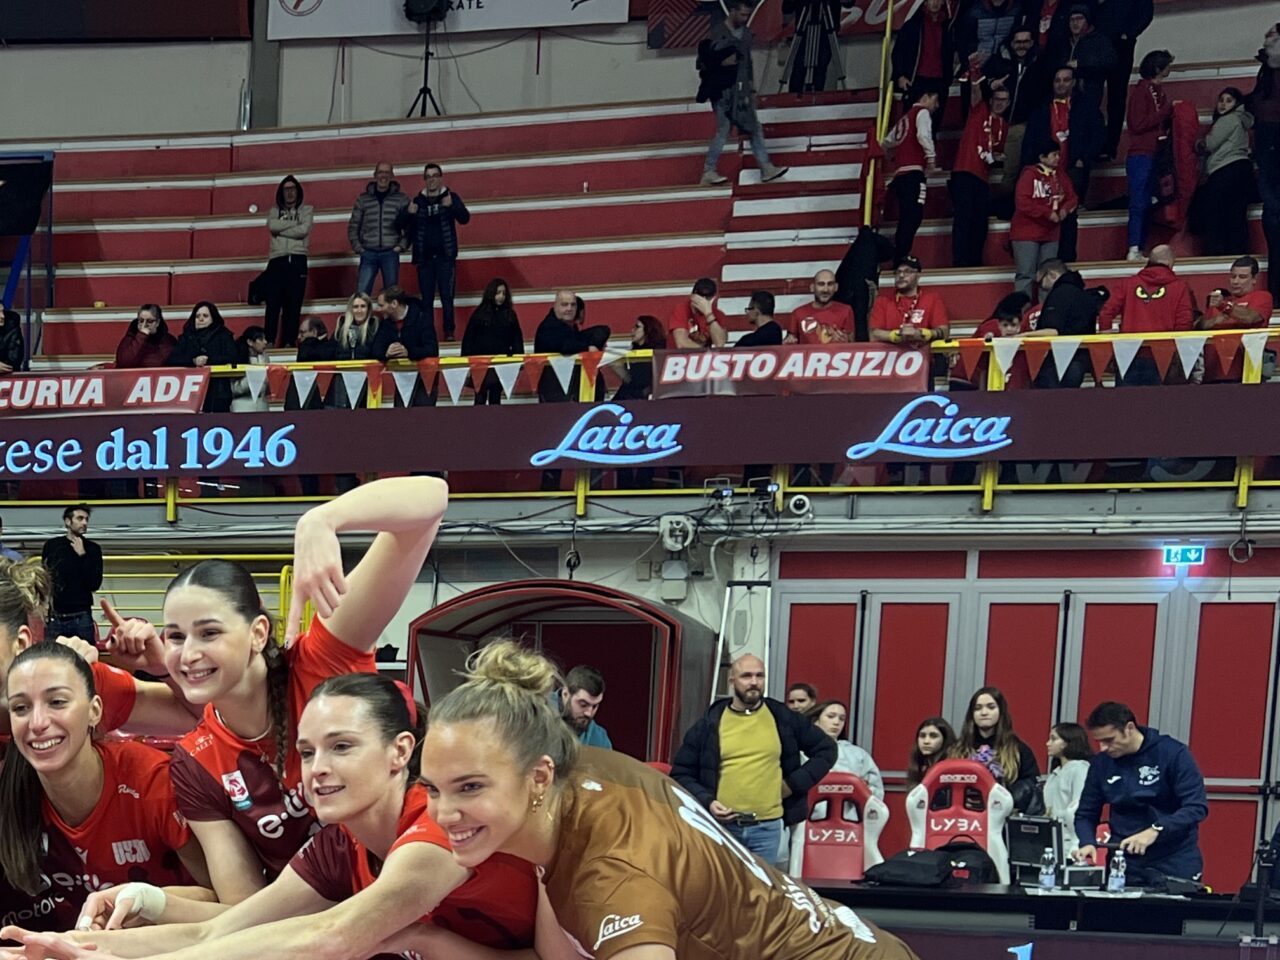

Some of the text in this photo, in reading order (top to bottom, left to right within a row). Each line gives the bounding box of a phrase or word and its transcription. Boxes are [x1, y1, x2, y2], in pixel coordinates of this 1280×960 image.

[661, 348, 924, 382] BUSTO ARSIZIO
[123, 374, 204, 403] ADF
[95, 425, 170, 470] dal
[179, 423, 298, 470] 1946
[530, 403, 683, 466] Laica
[846, 394, 1013, 460] Laica
[592, 913, 644, 950] Laica
